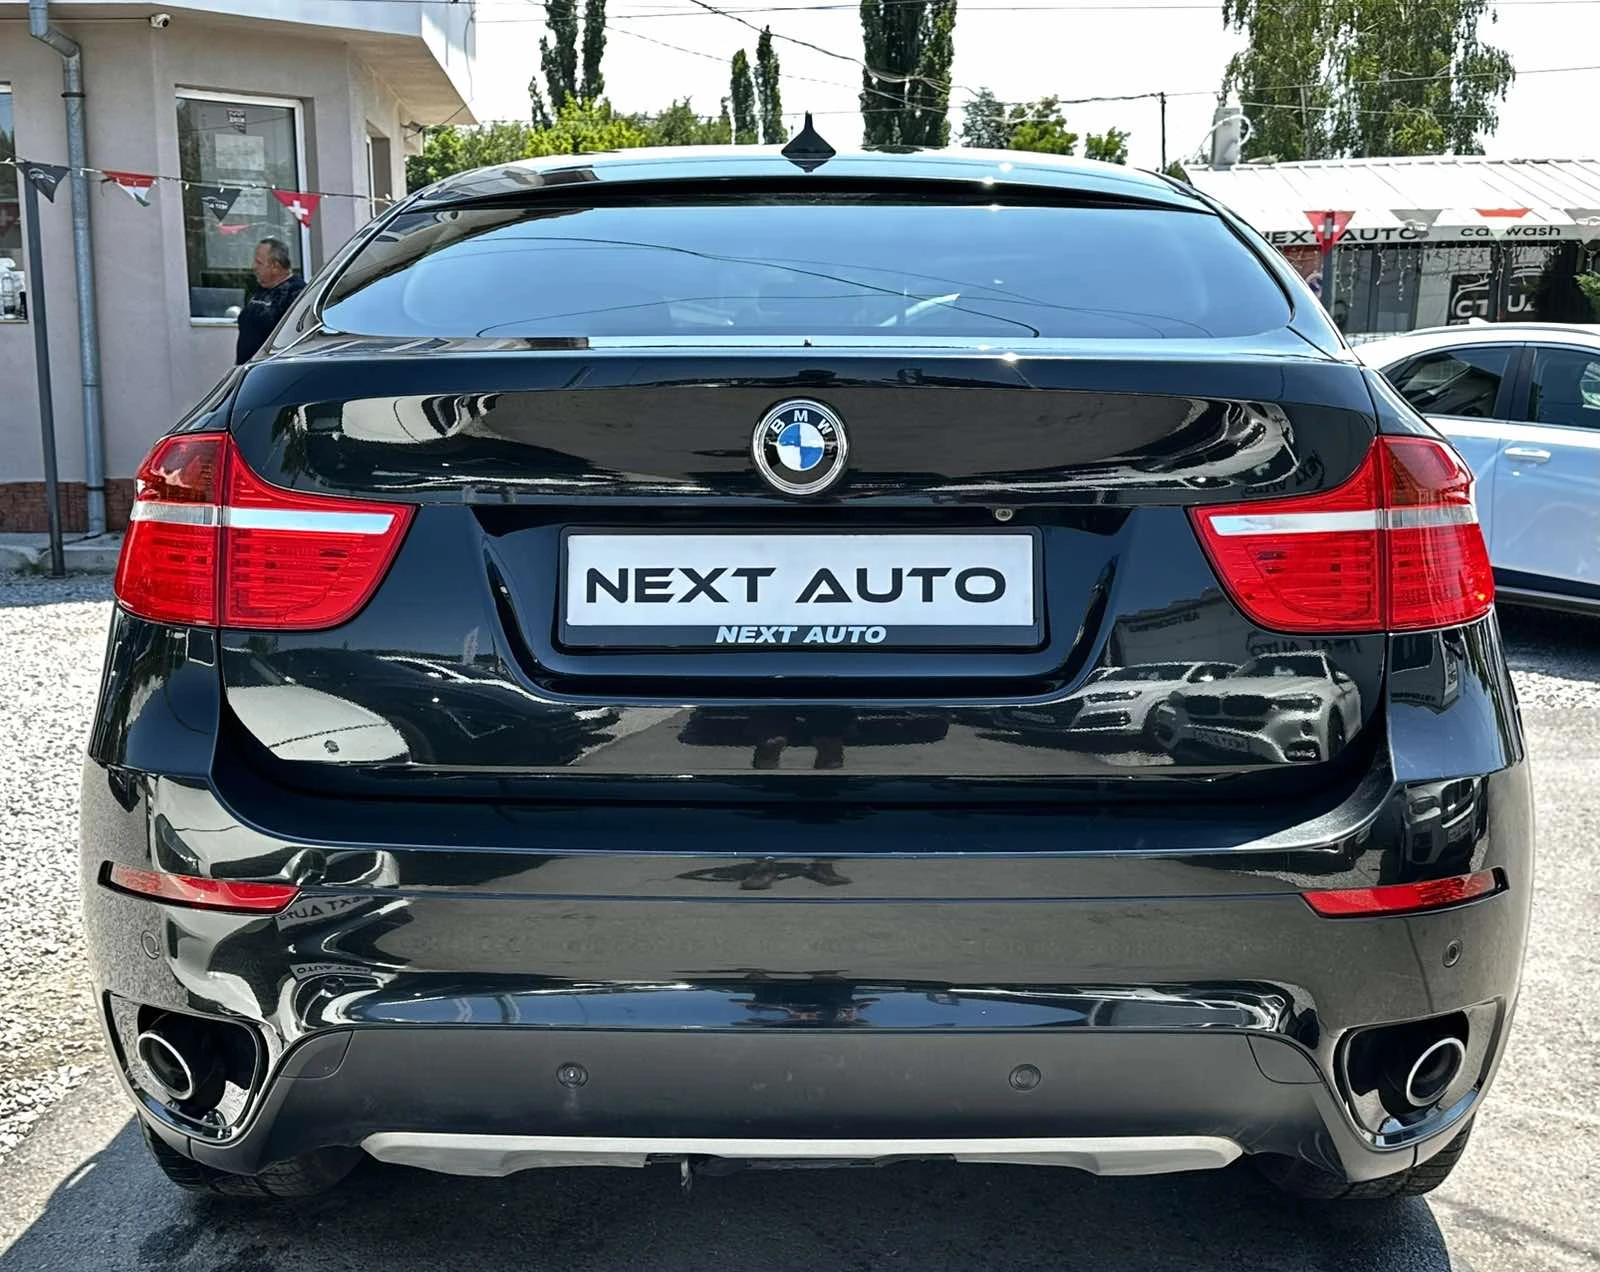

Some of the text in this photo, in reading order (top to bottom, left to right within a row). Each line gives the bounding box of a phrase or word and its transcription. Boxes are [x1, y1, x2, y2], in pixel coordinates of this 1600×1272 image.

[1460, 225, 1561, 237] ca wash
[770, 410, 833, 436] BMW
[586, 567, 1007, 604] NEXT AUTO
[715, 626, 887, 644] NEXT AUTO
